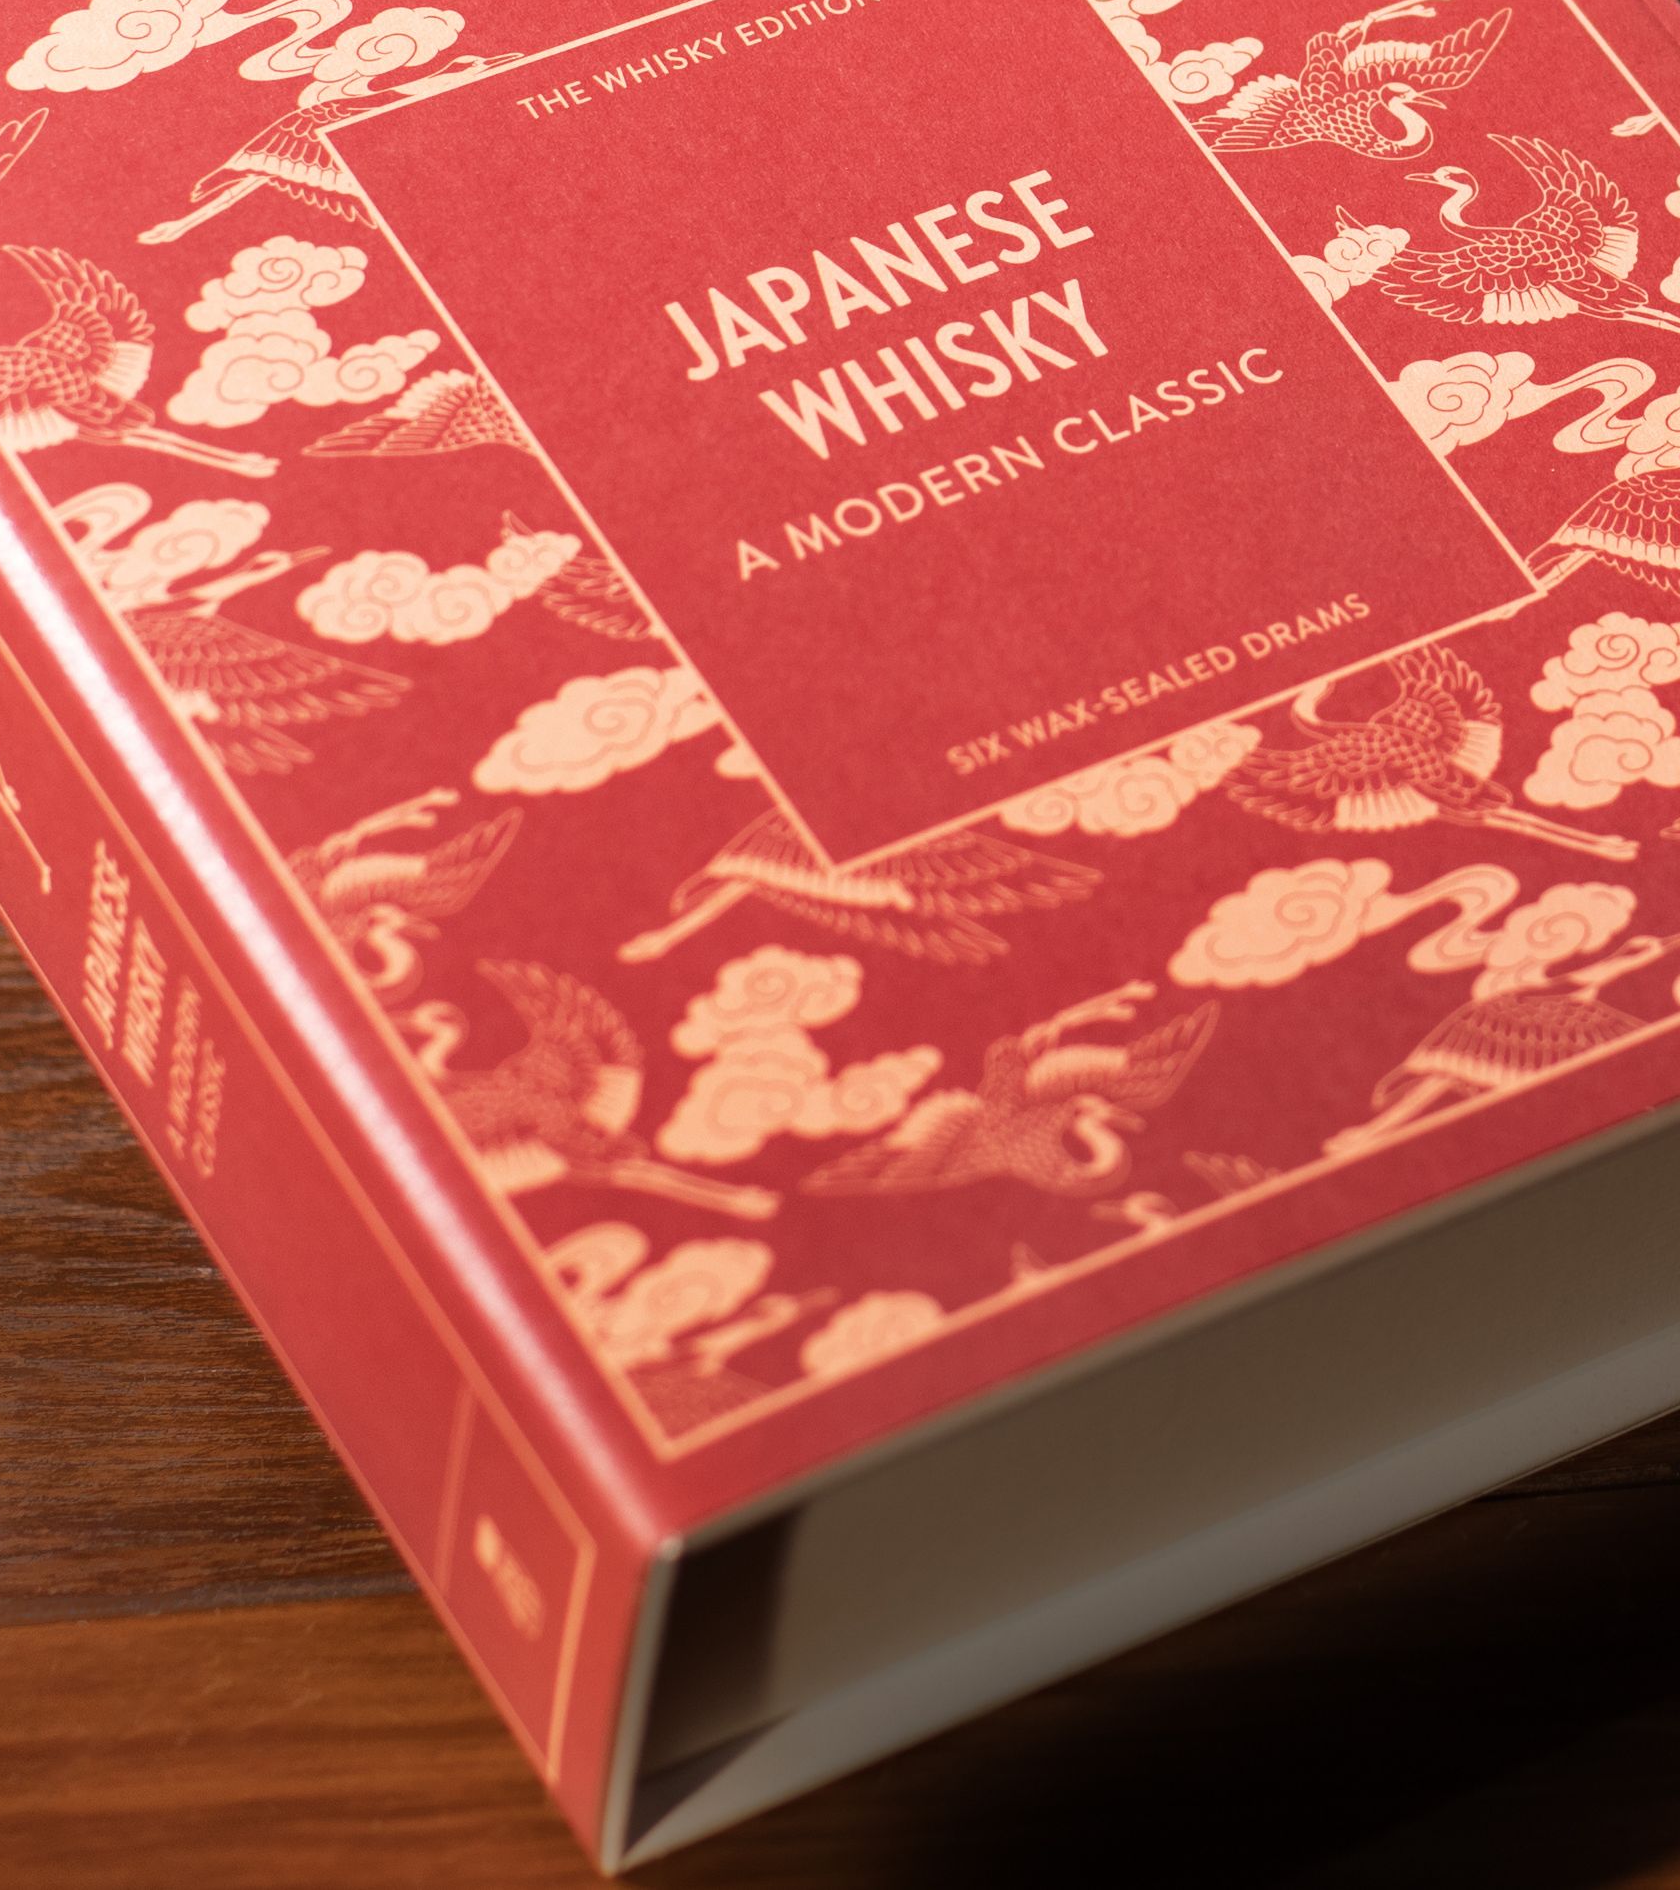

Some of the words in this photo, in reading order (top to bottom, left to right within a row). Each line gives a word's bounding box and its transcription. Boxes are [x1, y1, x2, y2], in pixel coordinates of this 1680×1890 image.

[517, 83, 592, 122] THE
[590, 31, 732, 94] WHISKY
[663, 169, 1094, 382] JAPANESE
[758, 279, 1110, 462] WHISKY
[736, 537, 782, 581] A
[786, 434, 1046, 562] MODERN
[1053, 347, 1286, 457] CLASSIC
[945, 736, 1002, 775] SIX
[1004, 644, 1240, 760] WAX-SEALED
[1242, 593, 1372, 665] DRAMS
